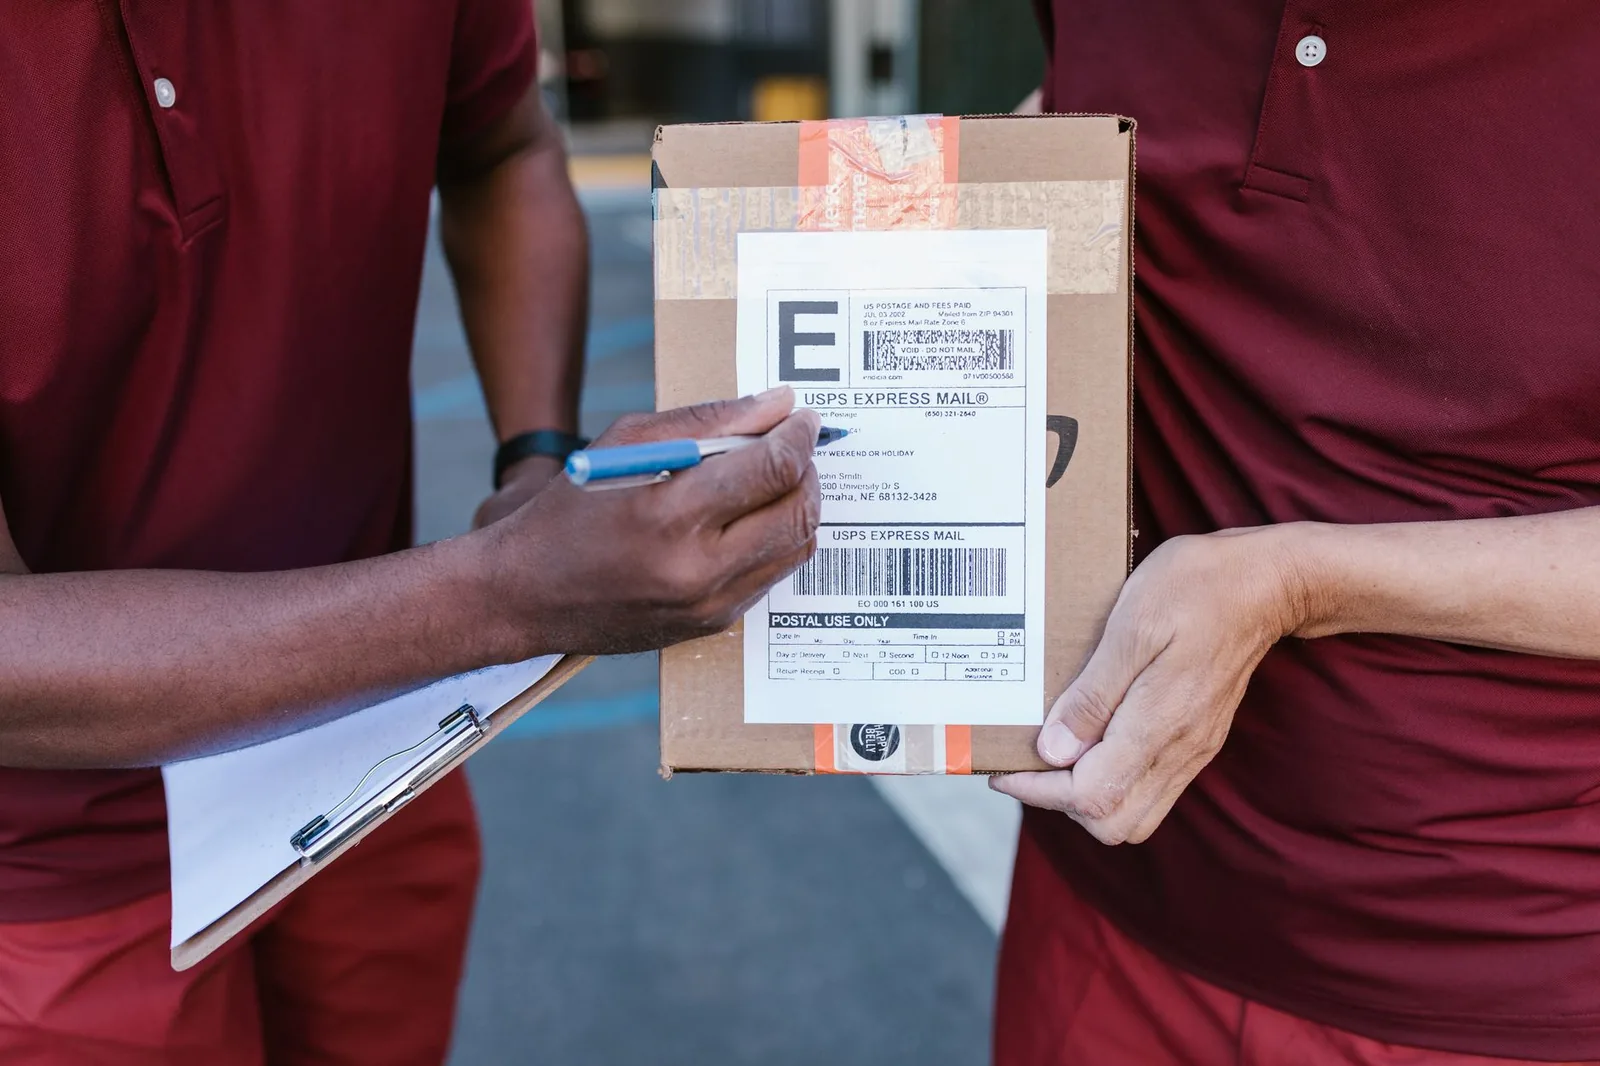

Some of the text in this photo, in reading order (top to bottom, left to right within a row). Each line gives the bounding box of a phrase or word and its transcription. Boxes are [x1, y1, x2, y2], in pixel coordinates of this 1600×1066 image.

[779, 301, 840, 381] E
[804, 392, 848, 405] USPS
[854, 392, 930, 405] EXPRESS
[840, 482, 880, 491] University
[860, 492, 875, 500] NE
[878, 492, 938, 501] 68132-3428
[832, 530, 965, 541] USPS EXPRESS MAIL
[772, 615, 890, 627] POSTAL USE ONLY
[865, 728, 876, 753] BELLY
[874, 724, 889, 752] HAPPY
